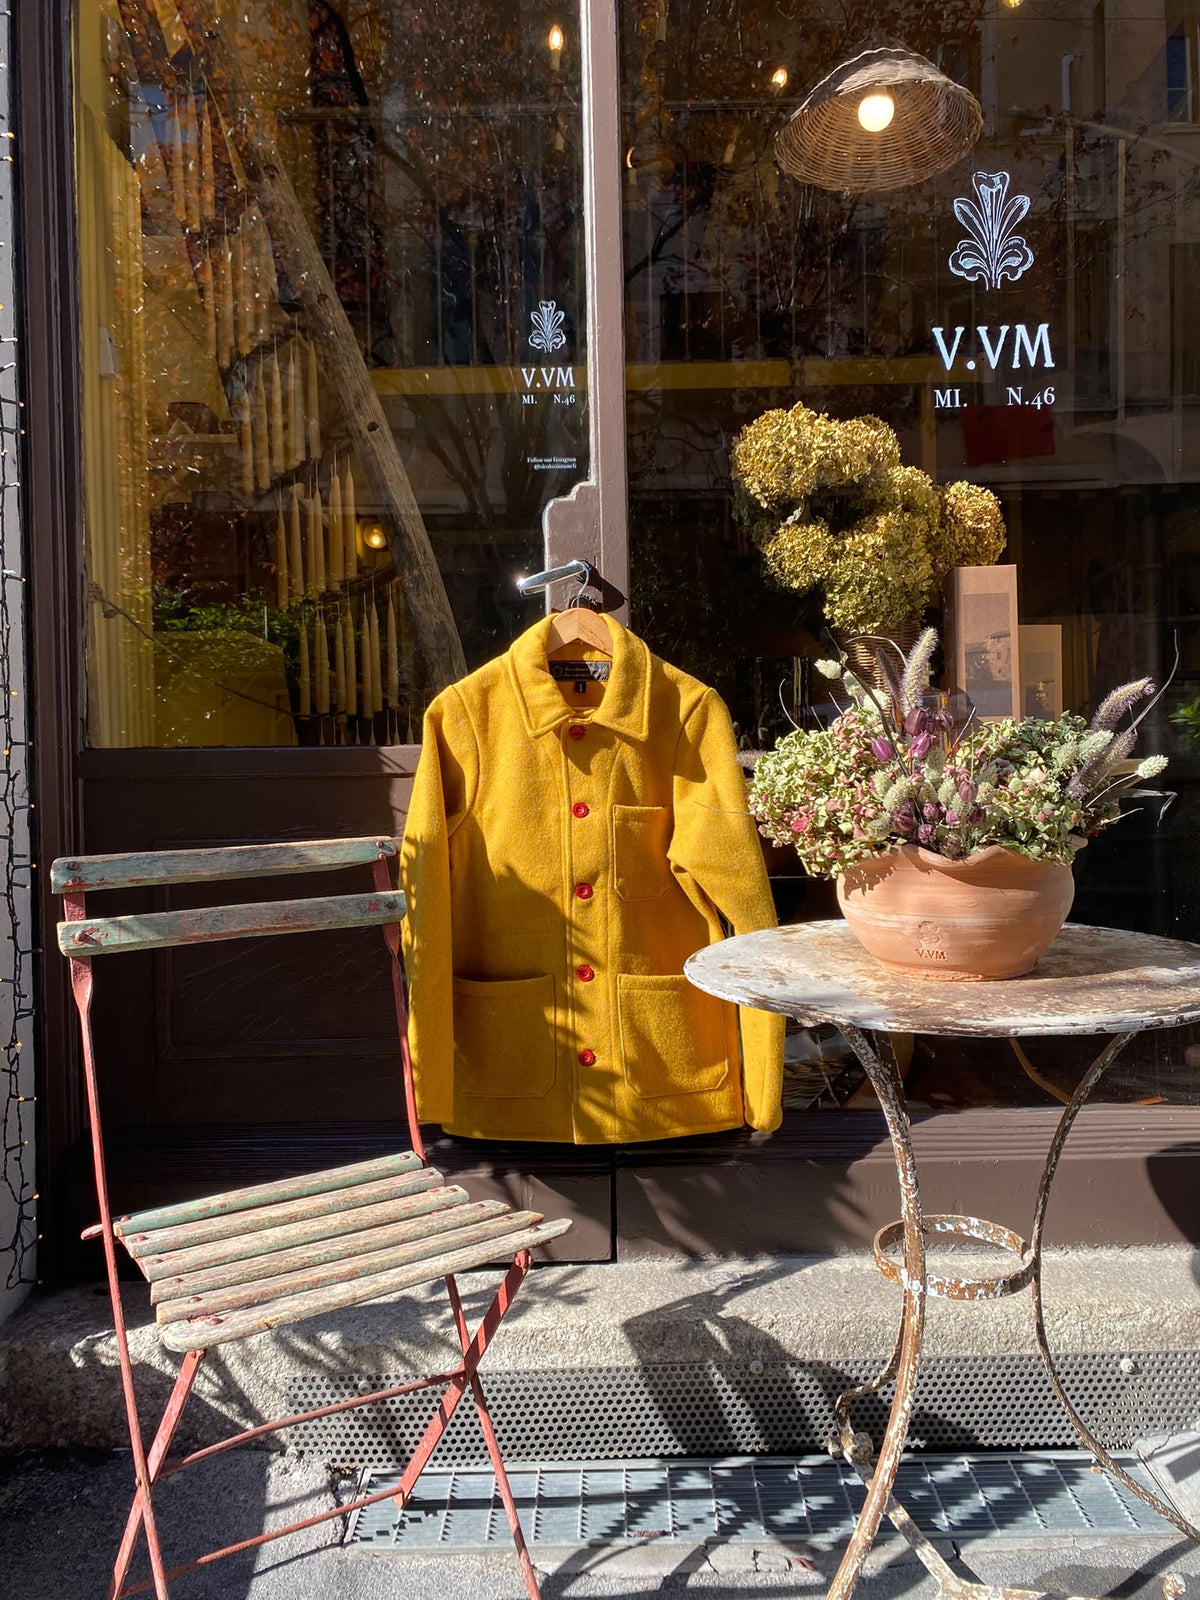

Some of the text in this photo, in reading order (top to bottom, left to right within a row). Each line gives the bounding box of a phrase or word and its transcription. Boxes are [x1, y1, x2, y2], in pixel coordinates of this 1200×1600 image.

[931, 323, 1056, 371] V.VM
[521, 366, 576, 389] V.VM
[522, 394, 576, 406] MI. N.46
[934, 386, 1056, 410] MI. N.46
[915, 948, 947, 960] V.VM
